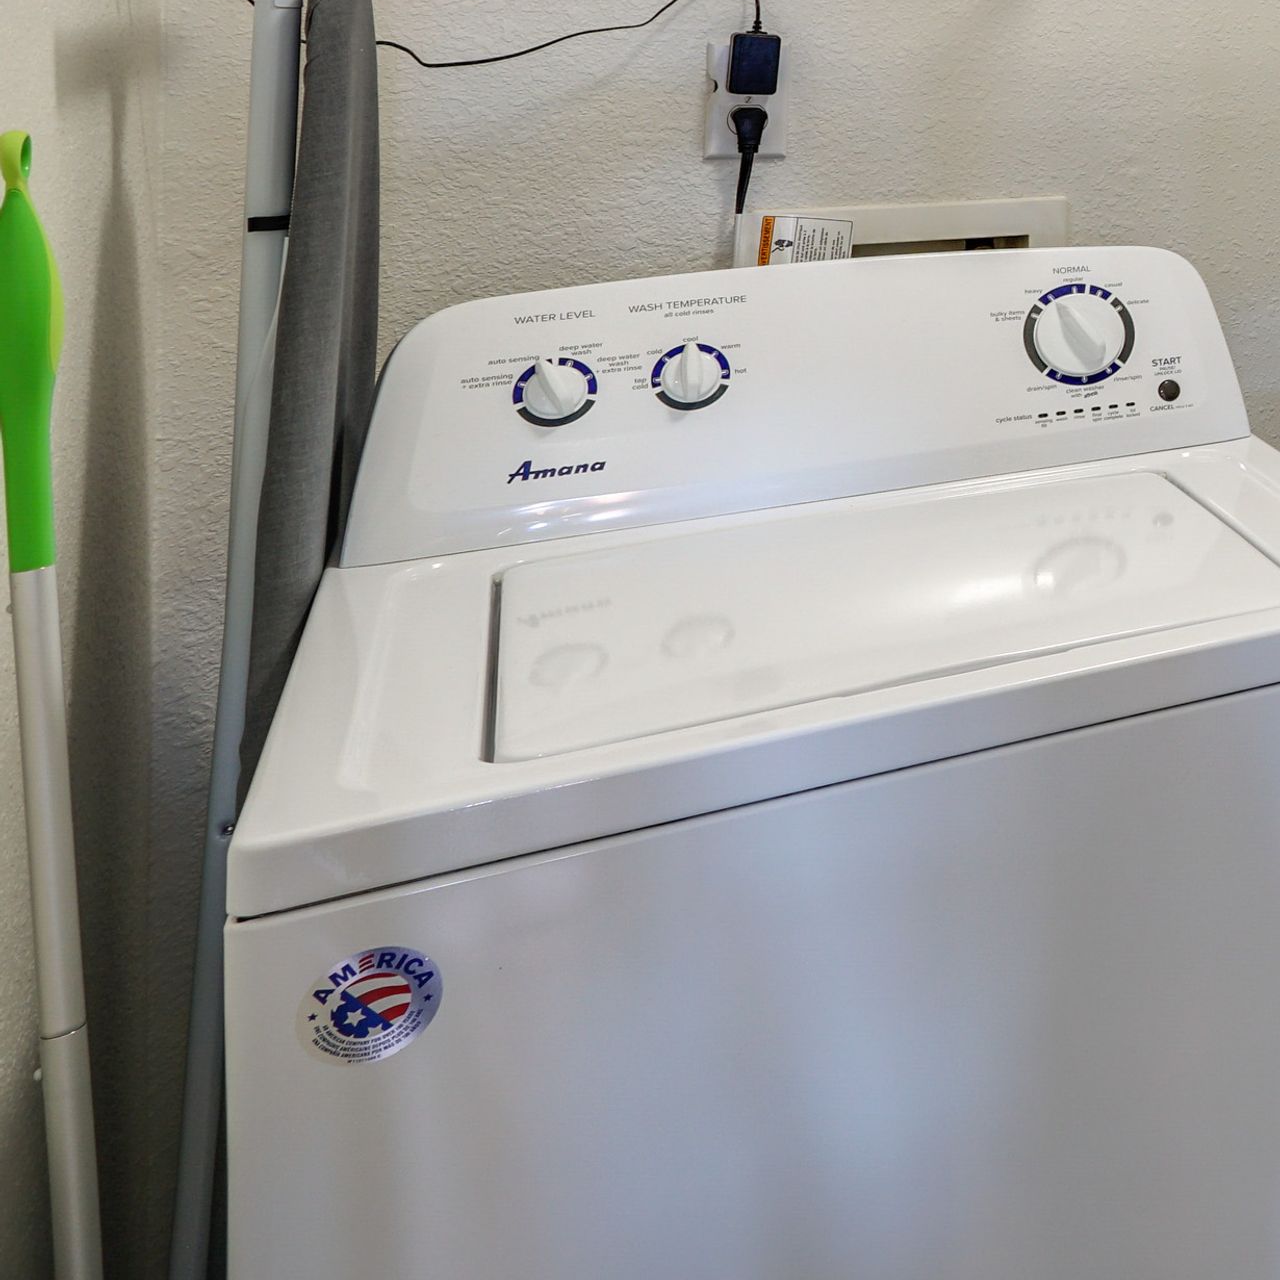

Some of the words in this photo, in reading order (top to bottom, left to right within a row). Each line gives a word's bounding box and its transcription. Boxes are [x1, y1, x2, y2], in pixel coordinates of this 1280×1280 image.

[1053, 265, 1090, 274] NORMAL
[628, 302, 663, 313] WASH
[665, 295, 747, 309] TEMPERATURE
[514, 314, 556, 325] WATER
[560, 310, 596, 320] LEVEL
[559, 344, 579, 353] deep
[581, 342, 603, 350] water
[509, 355, 540, 365] sensing
[597, 356, 617, 365] deep
[1152, 356, 1182, 367] START
[482, 373, 513, 384] sensing
[1113, 374, 1142, 382] rinse/spin
[1026, 384, 1057, 392] drain/spin
[1150, 404, 1174, 412] CANCEL
[507, 460, 606, 484] Amana
[312, 952, 435, 1006] AMERICA
